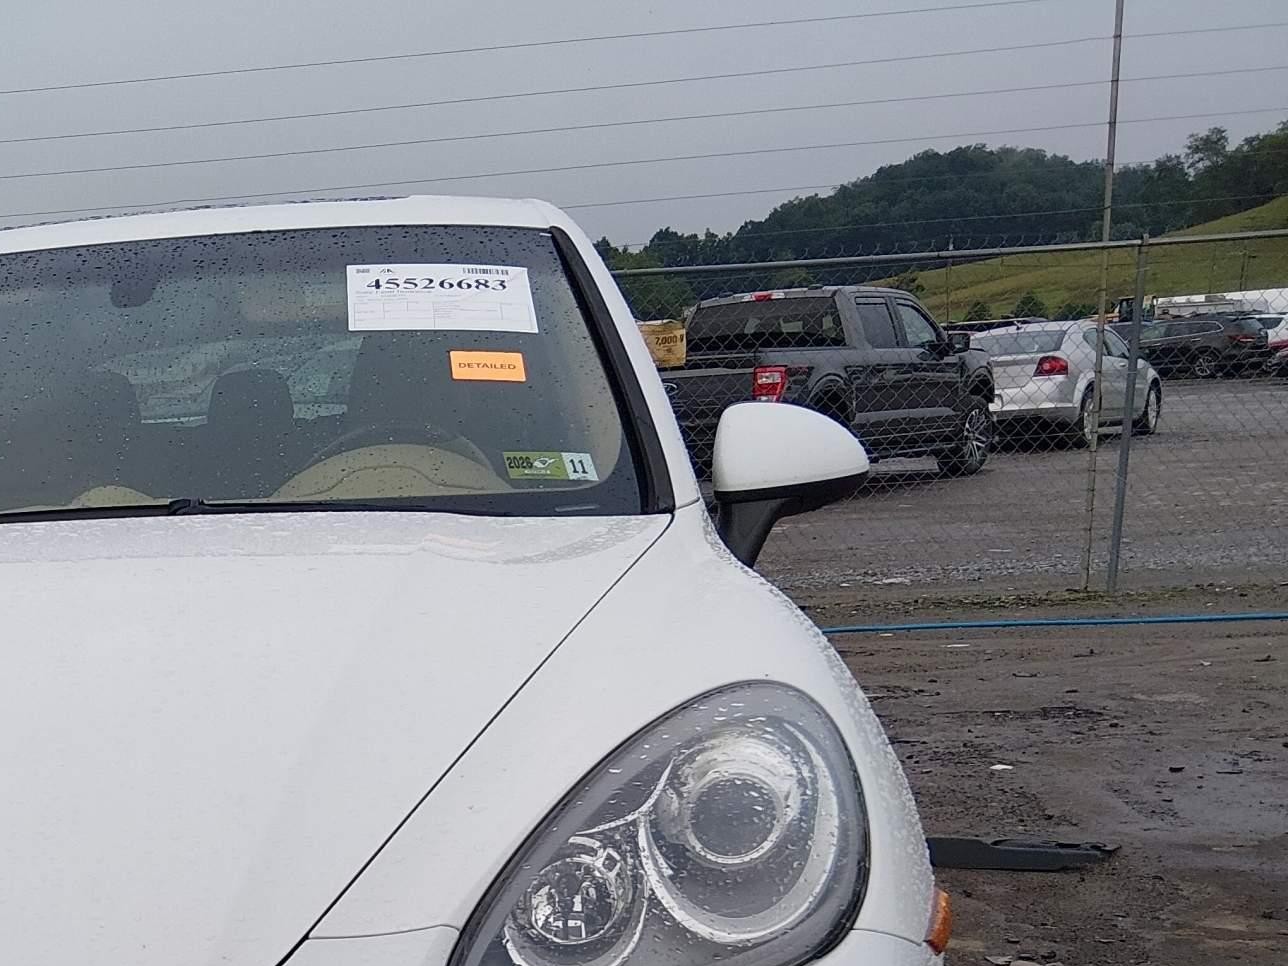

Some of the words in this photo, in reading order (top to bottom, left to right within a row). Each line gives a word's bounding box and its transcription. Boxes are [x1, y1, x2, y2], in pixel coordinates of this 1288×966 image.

[366, 278, 507, 291] 45526683
[655, 334, 678, 346] 7,000
[458, 362, 517, 370] DETAILED
[506, 456, 534, 469] 2026
[568, 459, 588, 474] 11
